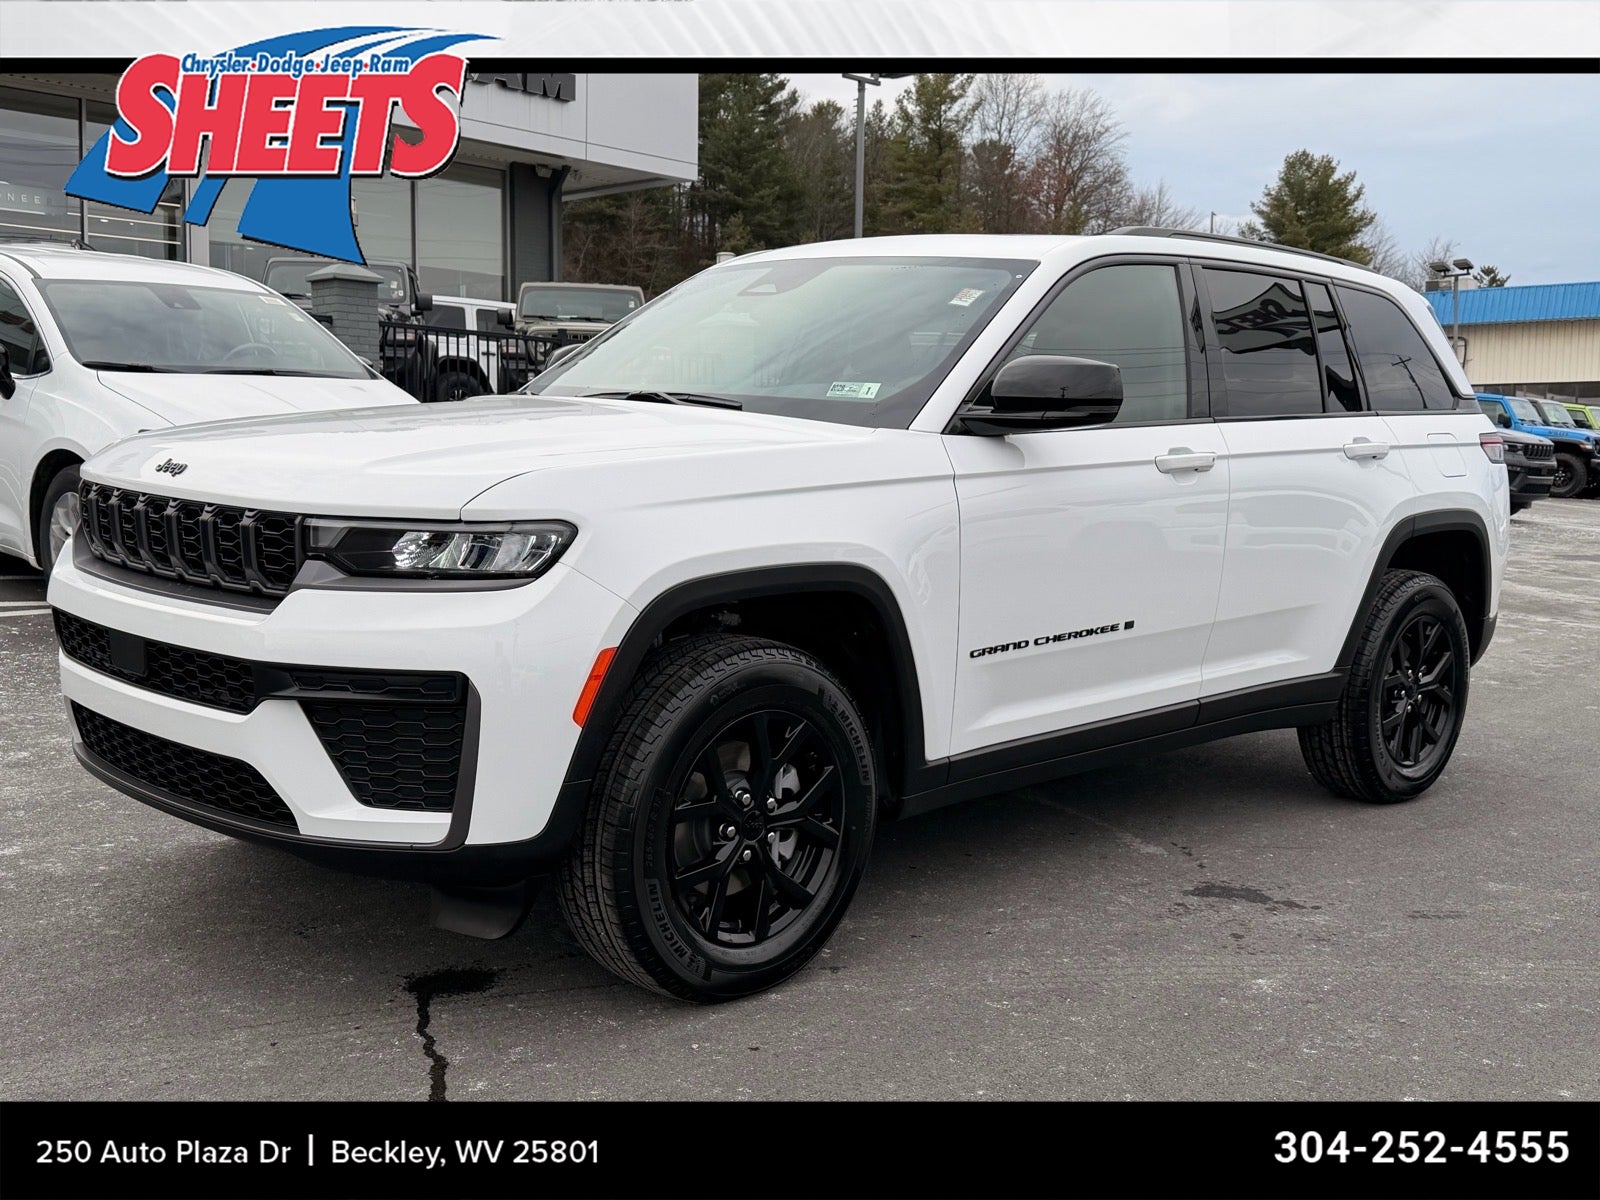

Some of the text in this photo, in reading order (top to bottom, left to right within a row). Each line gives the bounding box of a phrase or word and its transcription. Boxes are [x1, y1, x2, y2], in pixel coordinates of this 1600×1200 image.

[155, 458, 188, 477] Jeep
[969, 622, 1120, 659] GRAND CHEROKEE
[838, 710, 870, 782] MICHELIN
[647, 883, 688, 959] MICHELIN
